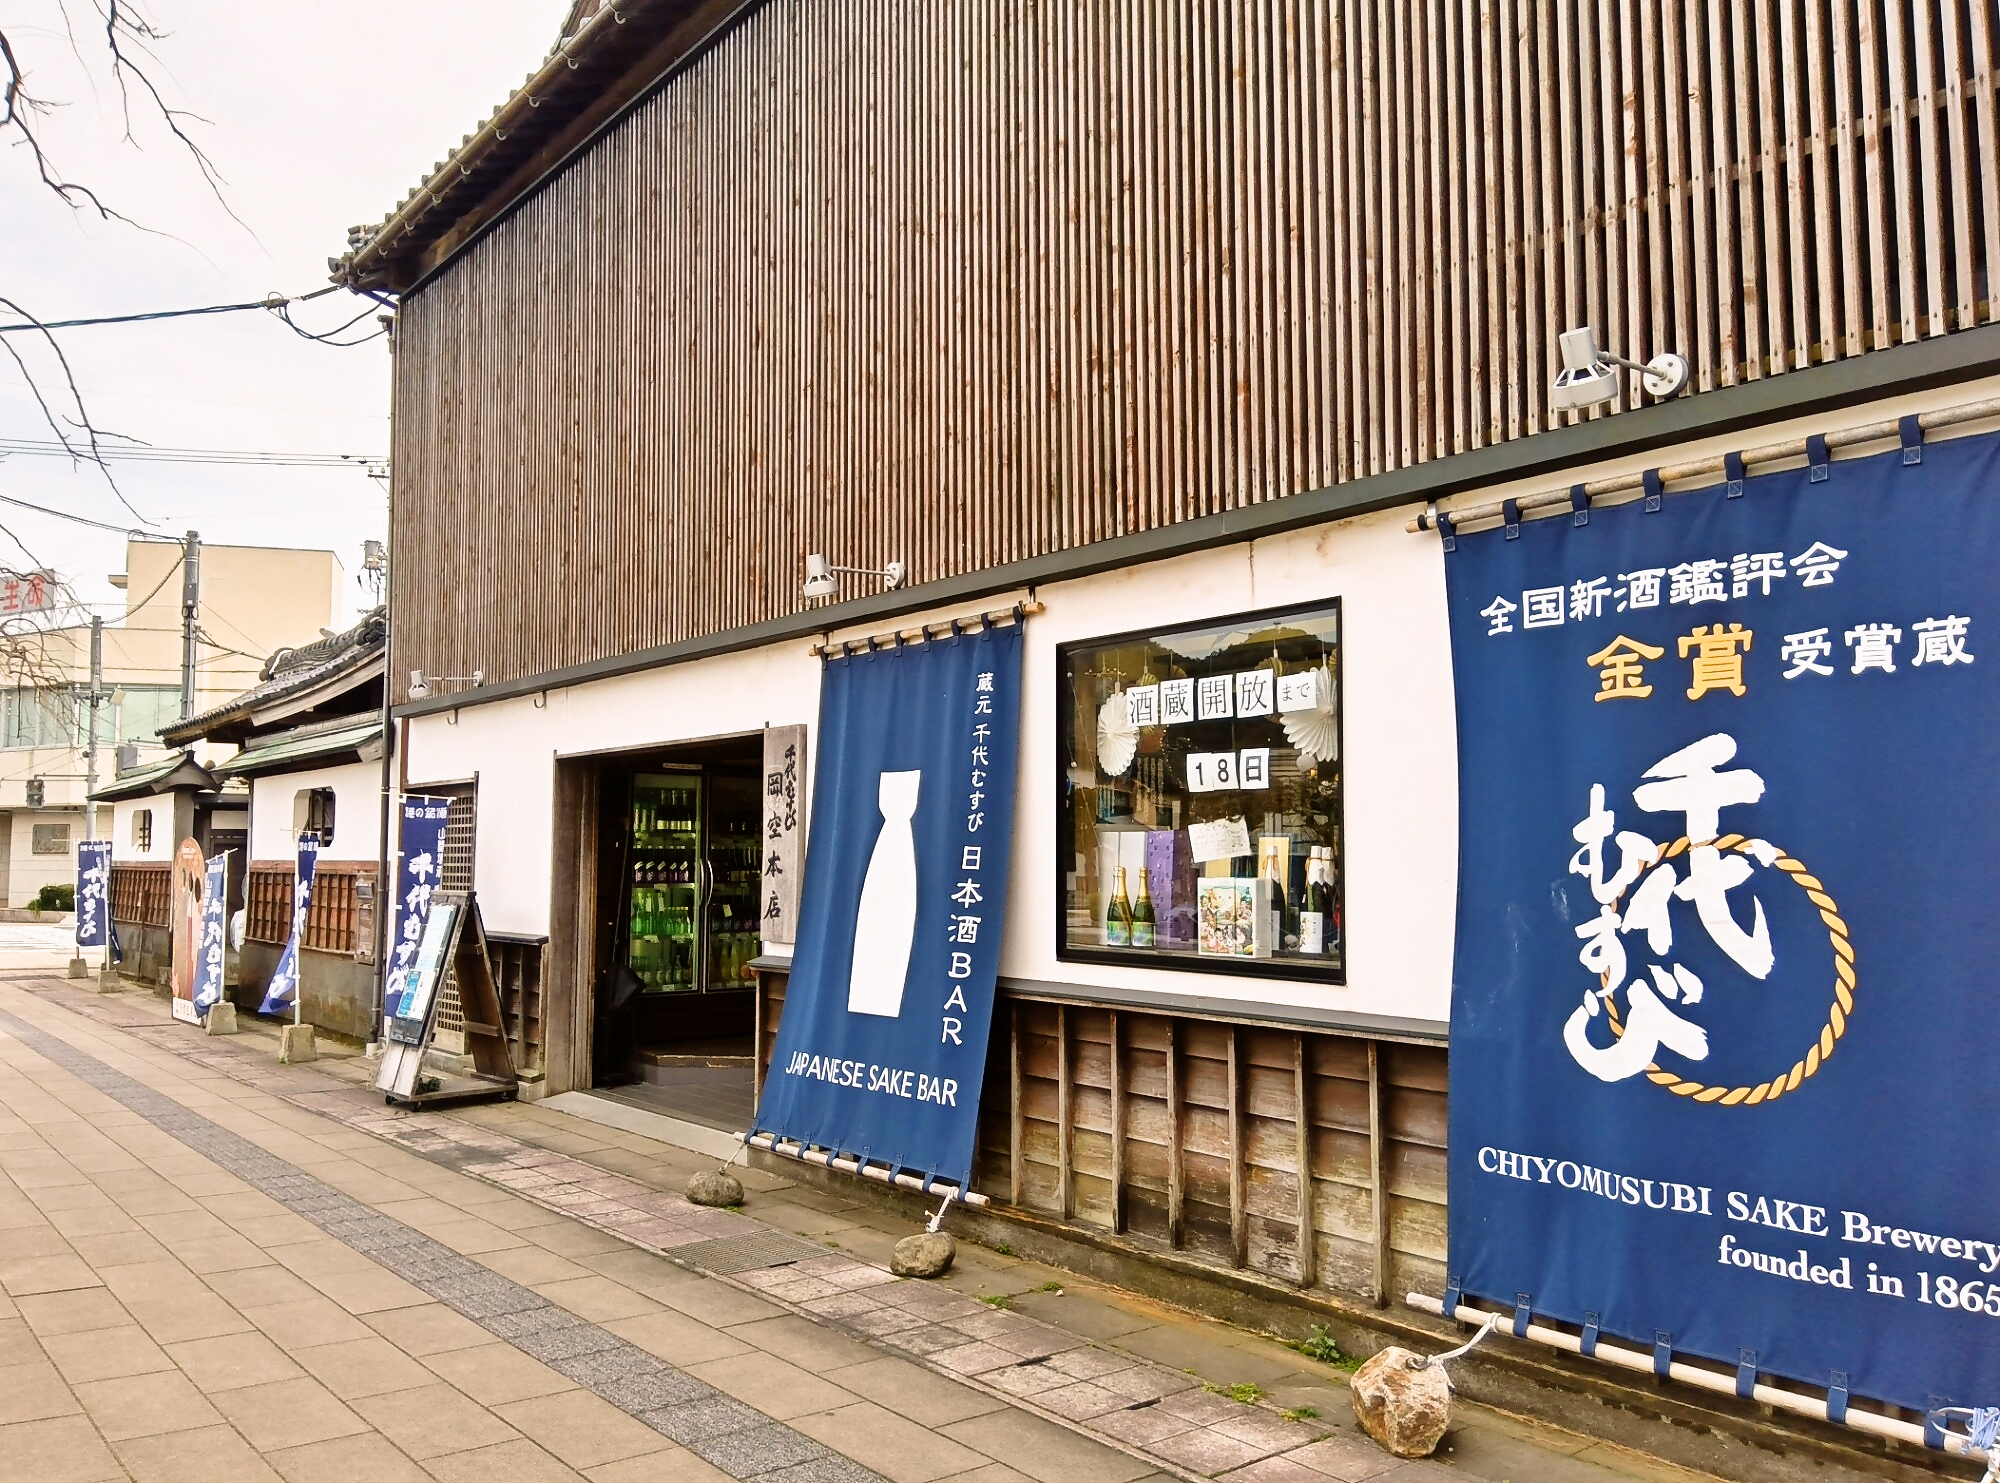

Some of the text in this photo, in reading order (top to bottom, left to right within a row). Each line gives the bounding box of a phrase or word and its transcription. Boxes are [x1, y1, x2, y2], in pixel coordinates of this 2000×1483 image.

[1480, 541, 1848, 637] 全国新酒鑑評会
[1587, 614, 1975, 702] 金賞 受賞蔵
[764, 772, 783, 920] 岡空本店
[941, 672, 994, 1046] 蔵元 千代むすび 日本酒BAR
[785, 1050, 958, 1107] JAPANESE SAKE BAR
[1477, 1146, 2000, 1273] CHIYOMUSUBI SAKE Brewery
[1718, 1235, 2000, 1317] founded in 1865
